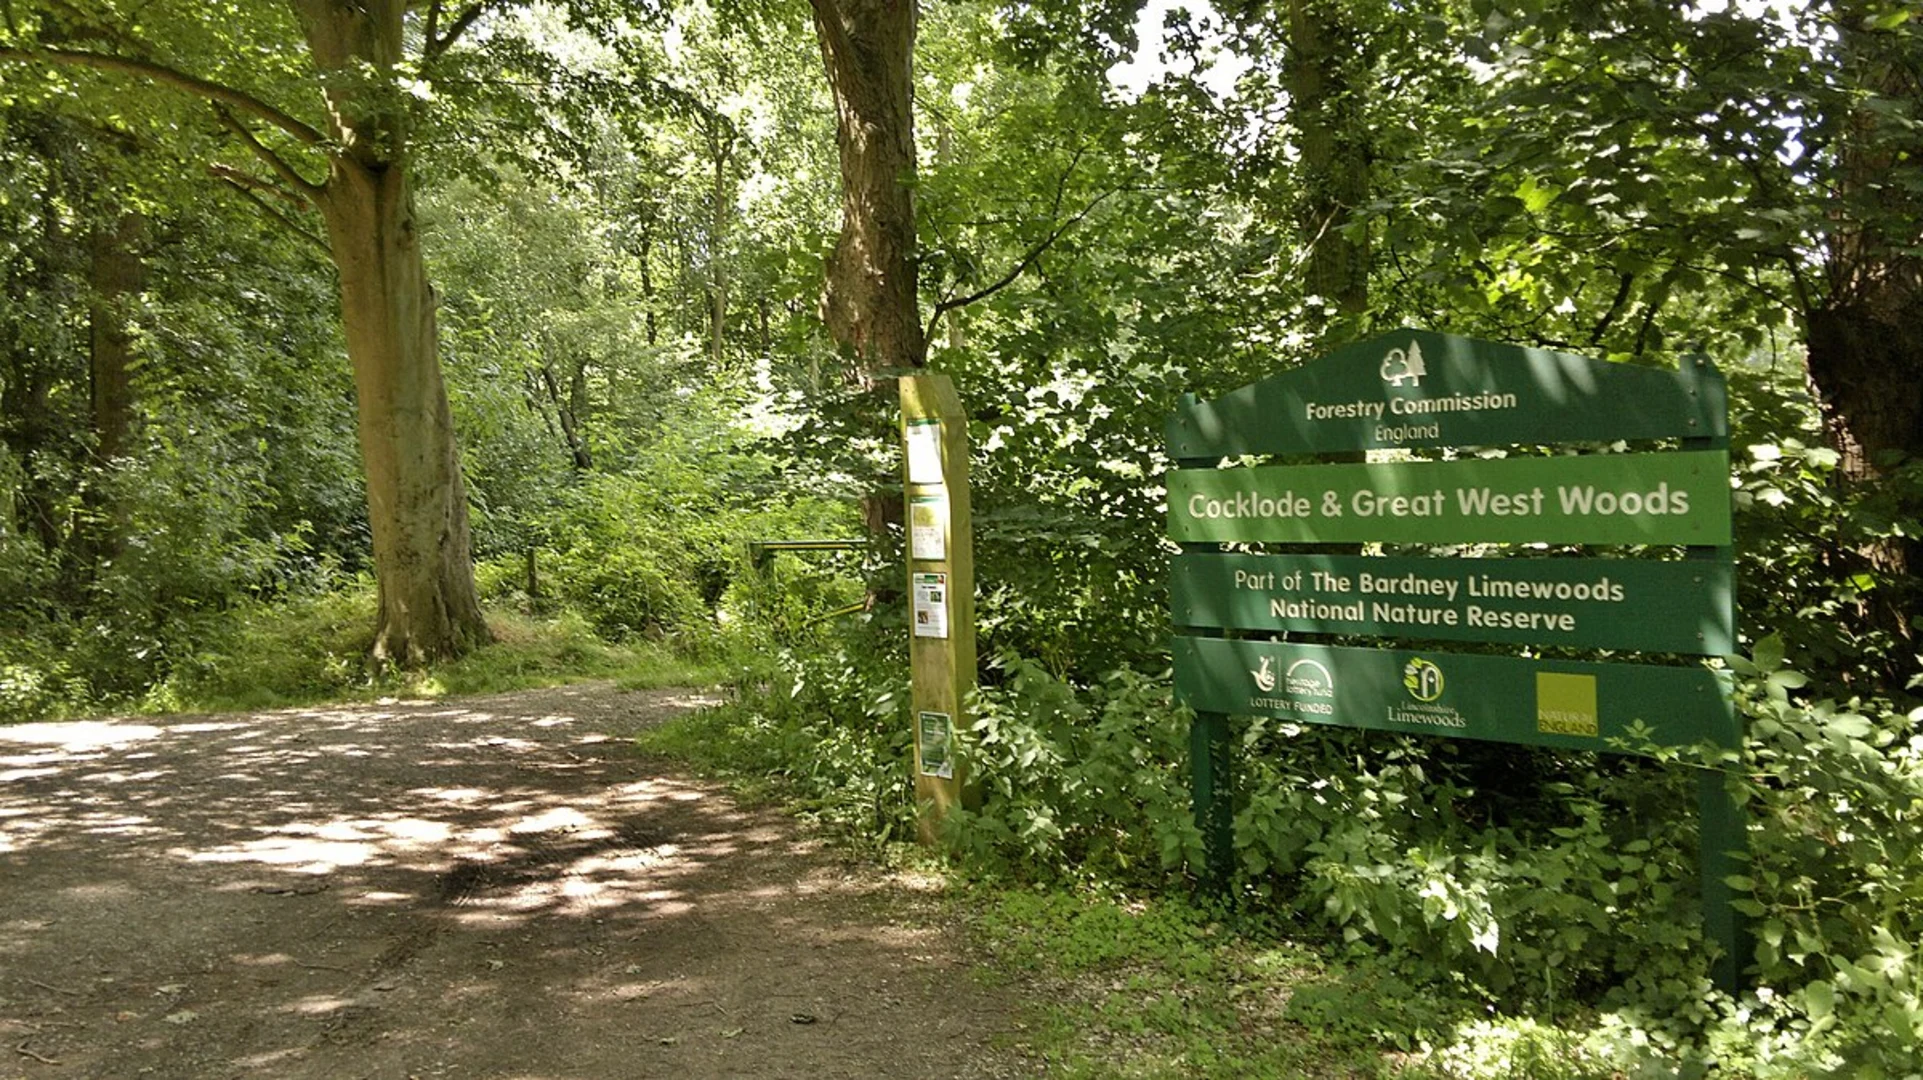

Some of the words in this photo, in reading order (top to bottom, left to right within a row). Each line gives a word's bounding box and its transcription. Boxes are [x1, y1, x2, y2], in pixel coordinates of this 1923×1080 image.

[1306, 401, 1384, 420] Forestry
[1390, 391, 1516, 414] Commission
[1374, 422, 1439, 444] England
[1188, 490, 1311, 518] Cocklode
[1320, 490, 1343, 517] &
[1352, 489, 1445, 516] Great
[1456, 487, 1544, 516] West
[1558, 481, 1690, 515] Woods
[1235, 570, 1274, 590] Part
[1282, 570, 1302, 591] of
[1311, 572, 1351, 592] The
[1360, 573, 1458, 601] Bardney
[1468, 575, 1625, 601] Limewoods
[1270, 598, 1364, 622] National
[1373, 602, 1458, 625] Nature
[1467, 605, 1576, 631] Reserve
[1250, 698, 1290, 710] LOTTERY
[1294, 701, 1333, 715] FUNDED
[1387, 706, 1467, 728] Limewoods
[1539, 719, 1597, 735] ENGLAND
